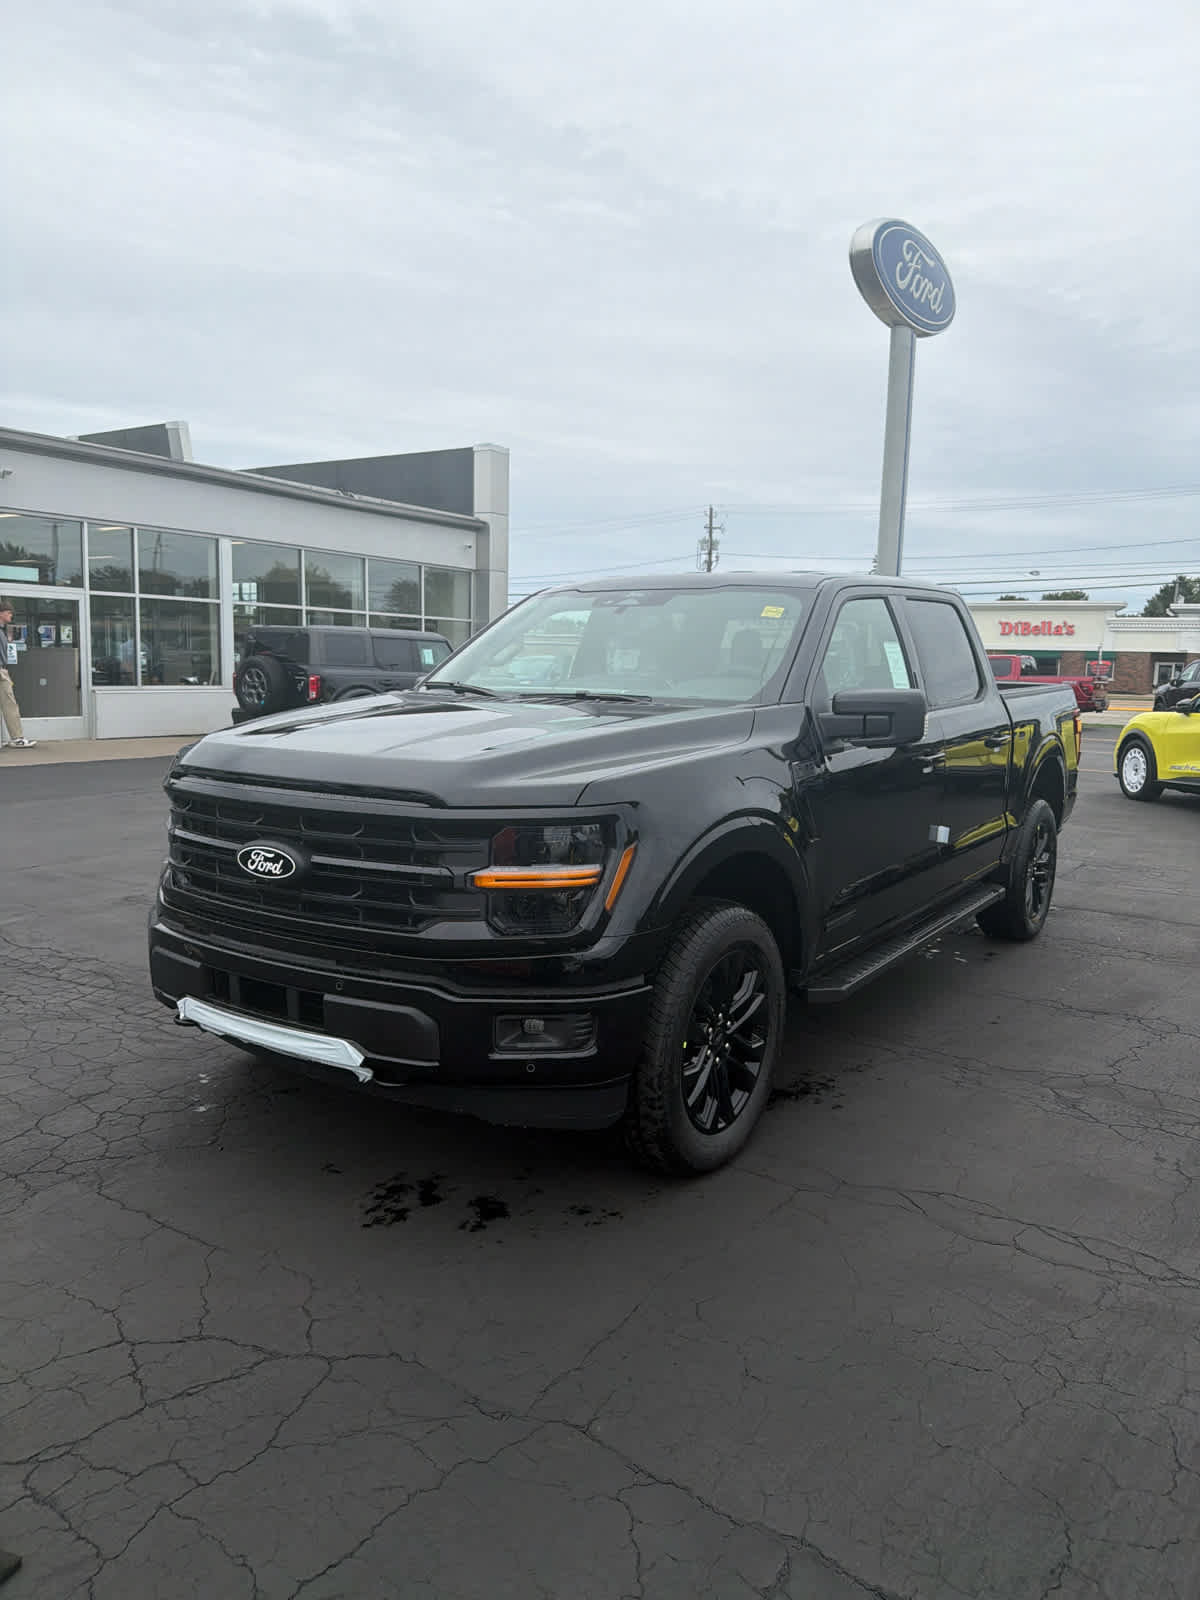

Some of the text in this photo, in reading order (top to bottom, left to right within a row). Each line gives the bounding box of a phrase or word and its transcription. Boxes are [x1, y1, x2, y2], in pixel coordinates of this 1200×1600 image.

[896, 239, 946, 314] Ford
[998, 620, 1075, 636] DiBella's
[248, 850, 284, 875] Ford
